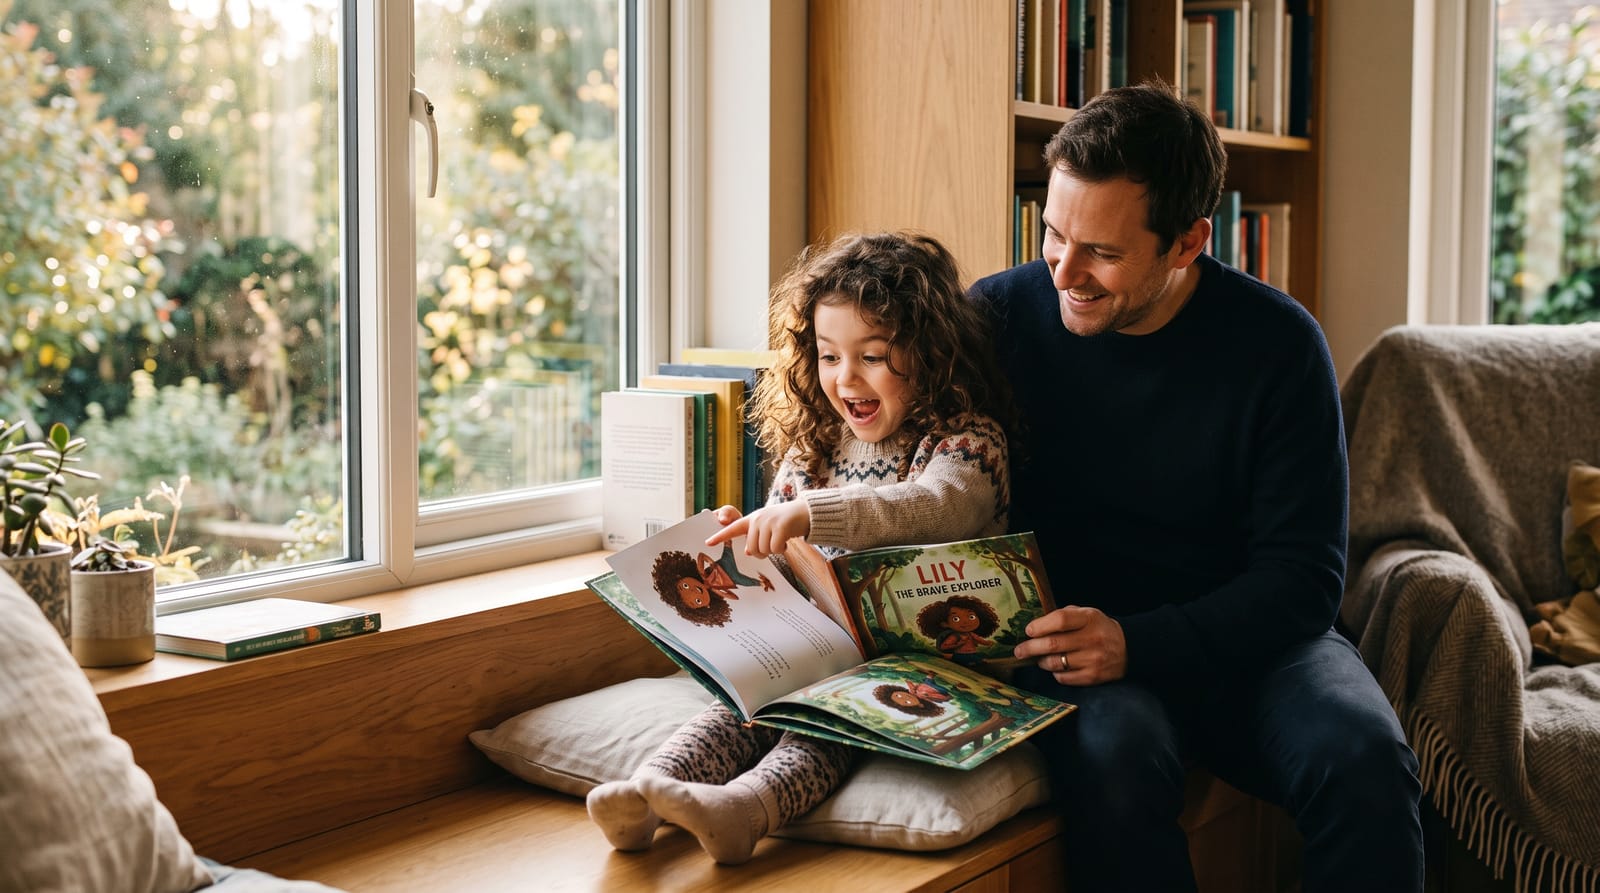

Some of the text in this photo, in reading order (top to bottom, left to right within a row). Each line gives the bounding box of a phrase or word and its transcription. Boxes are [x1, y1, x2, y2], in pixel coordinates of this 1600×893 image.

[916, 560, 965, 584] LILY
[895, 577, 1002, 599] THE BRAVE EXPLORER
